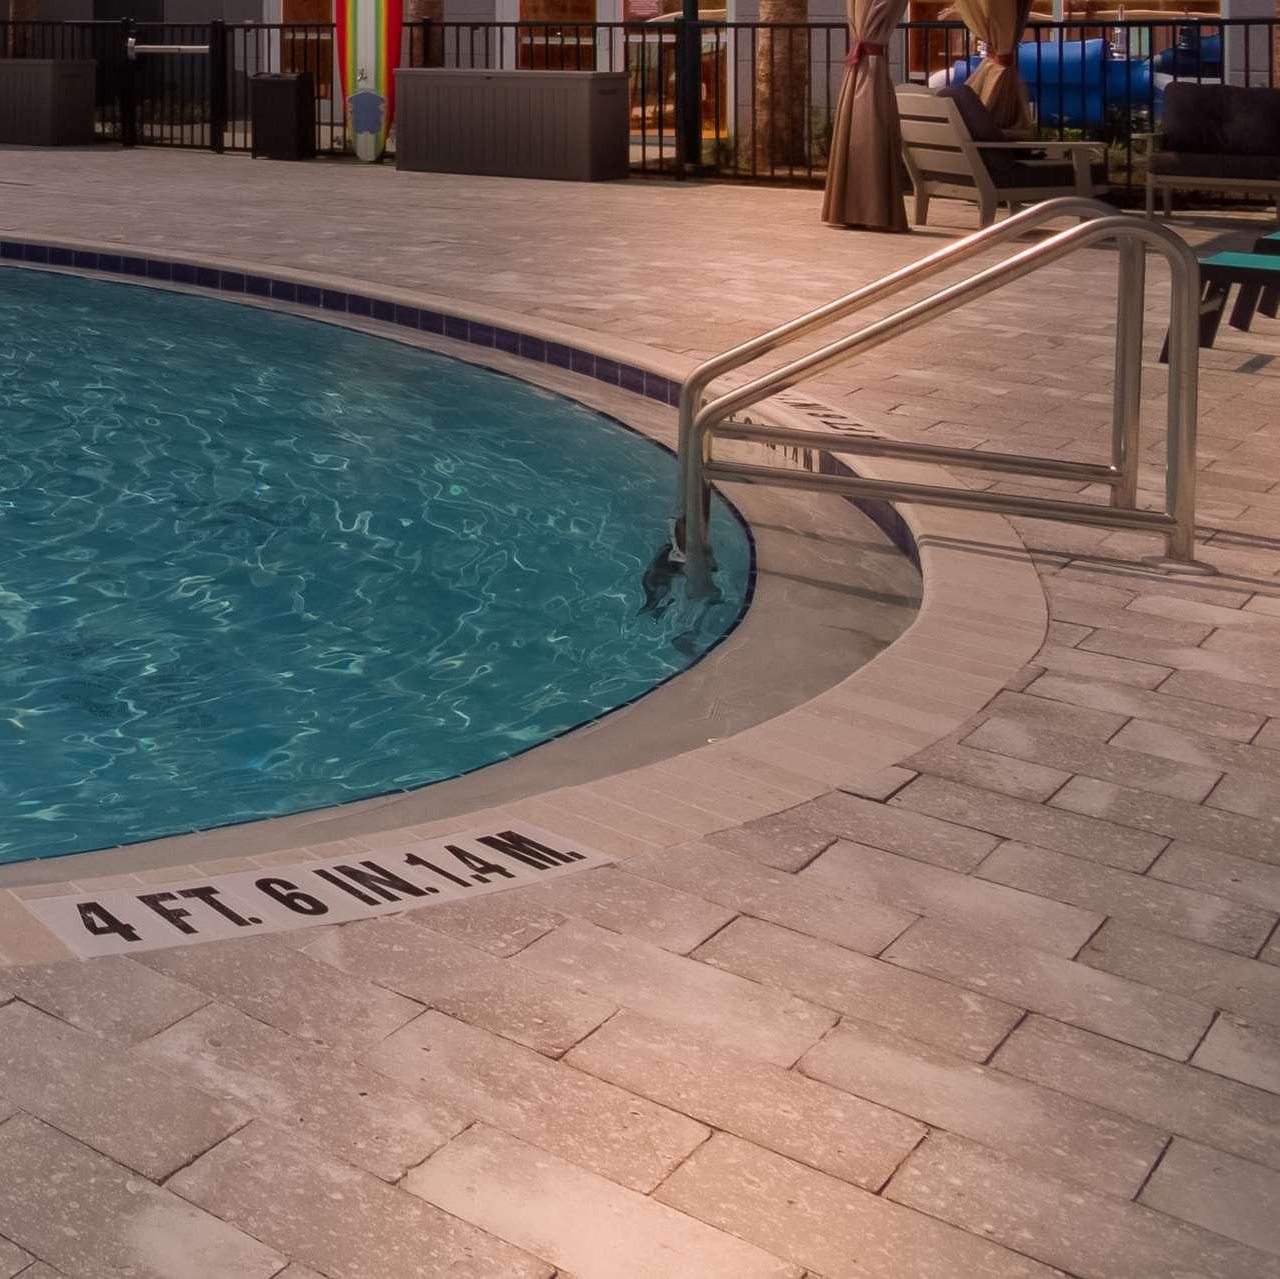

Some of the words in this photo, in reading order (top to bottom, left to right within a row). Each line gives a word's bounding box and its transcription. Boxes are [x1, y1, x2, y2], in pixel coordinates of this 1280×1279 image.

[76, 901, 143, 943] 4
[136, 886, 263, 935] FT.
[254, 877, 330, 917] 6
[312, 860, 440, 907] IN.
[476, 829, 588, 872] M.
